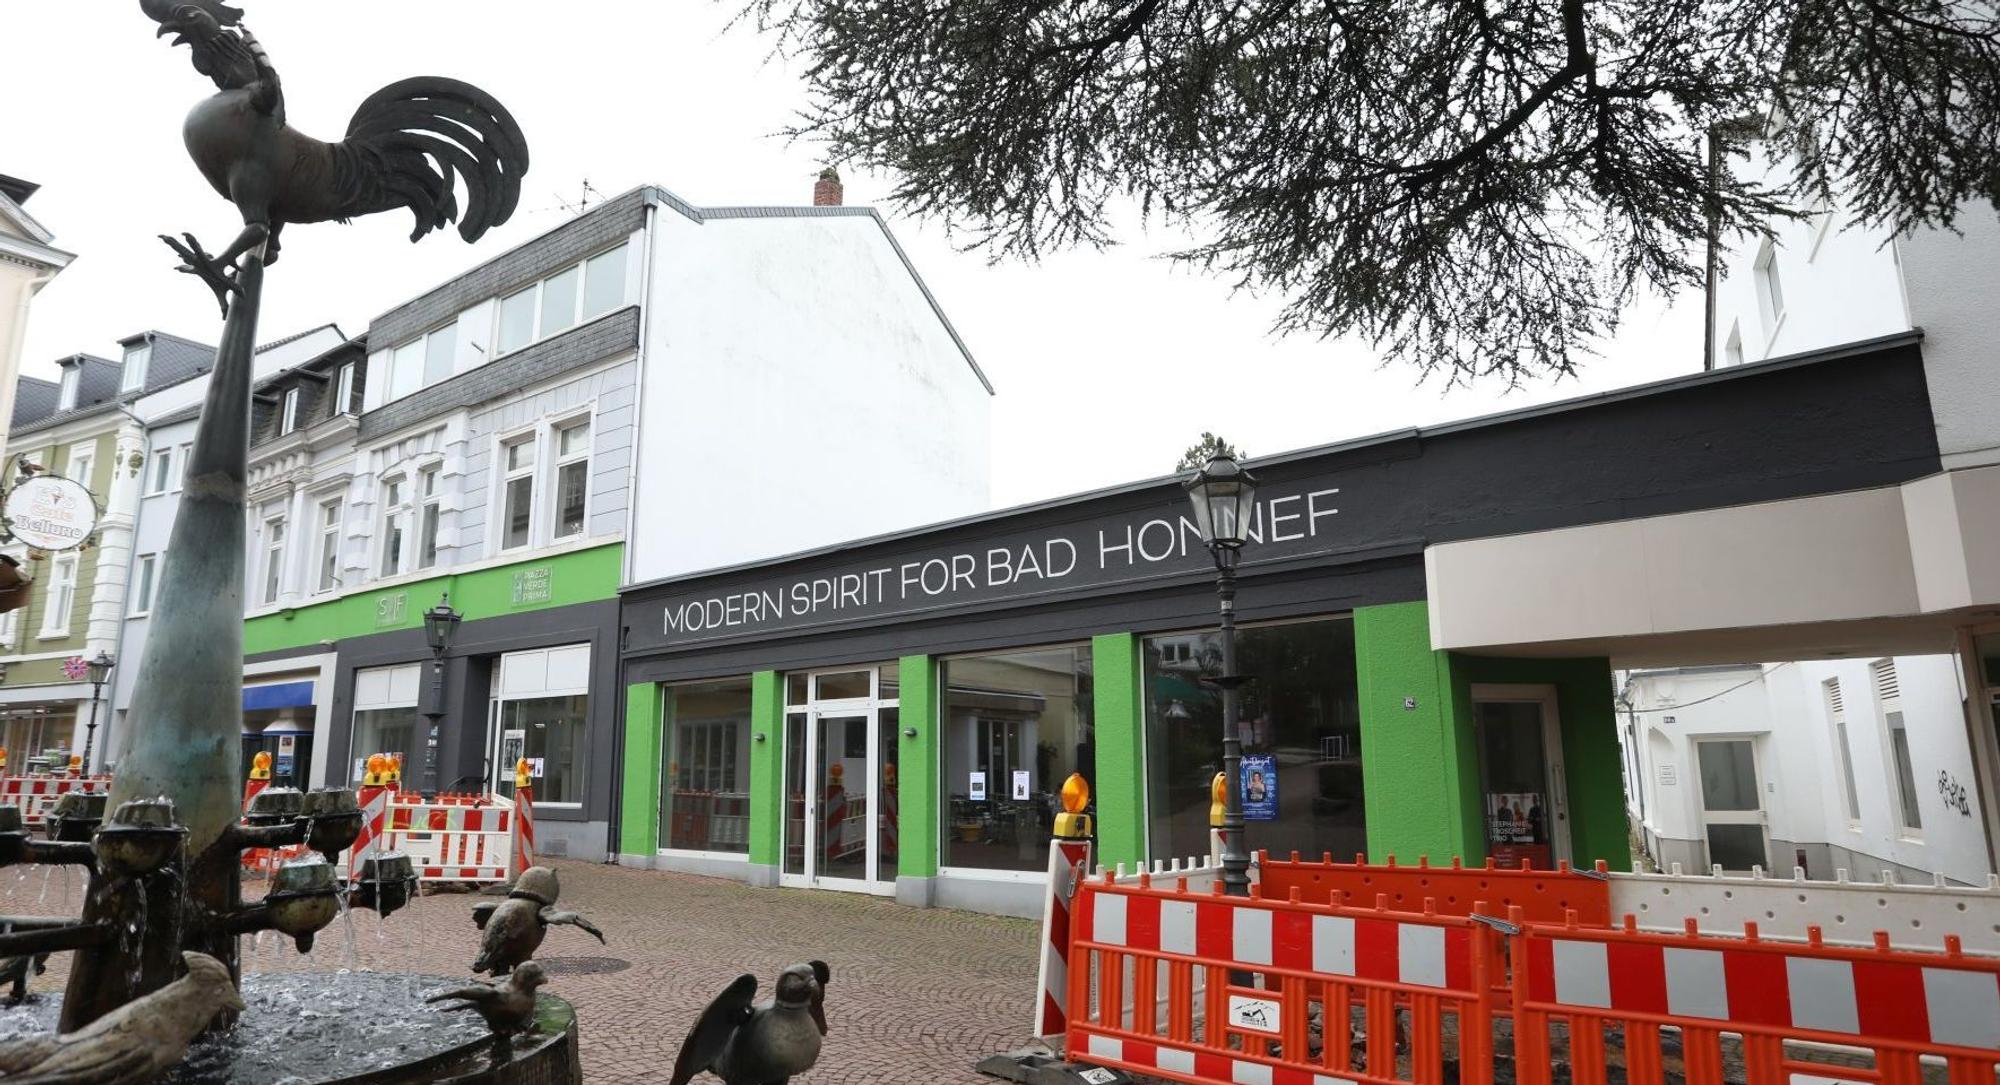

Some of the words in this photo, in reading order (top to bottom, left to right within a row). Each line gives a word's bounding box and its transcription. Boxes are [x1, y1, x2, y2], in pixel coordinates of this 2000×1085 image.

[15, 514, 83, 539] Belluno
[663, 587, 784, 636] MODERN
[791, 567, 893, 616] SPIRIT
[900, 554, 976, 600] FOR
[986, 537, 1077, 587] BAD
[1098, 487, 1340, 570] HONNEF
[523, 578, 548, 591] VERDE
[522, 589, 549, 602] PRIMA
